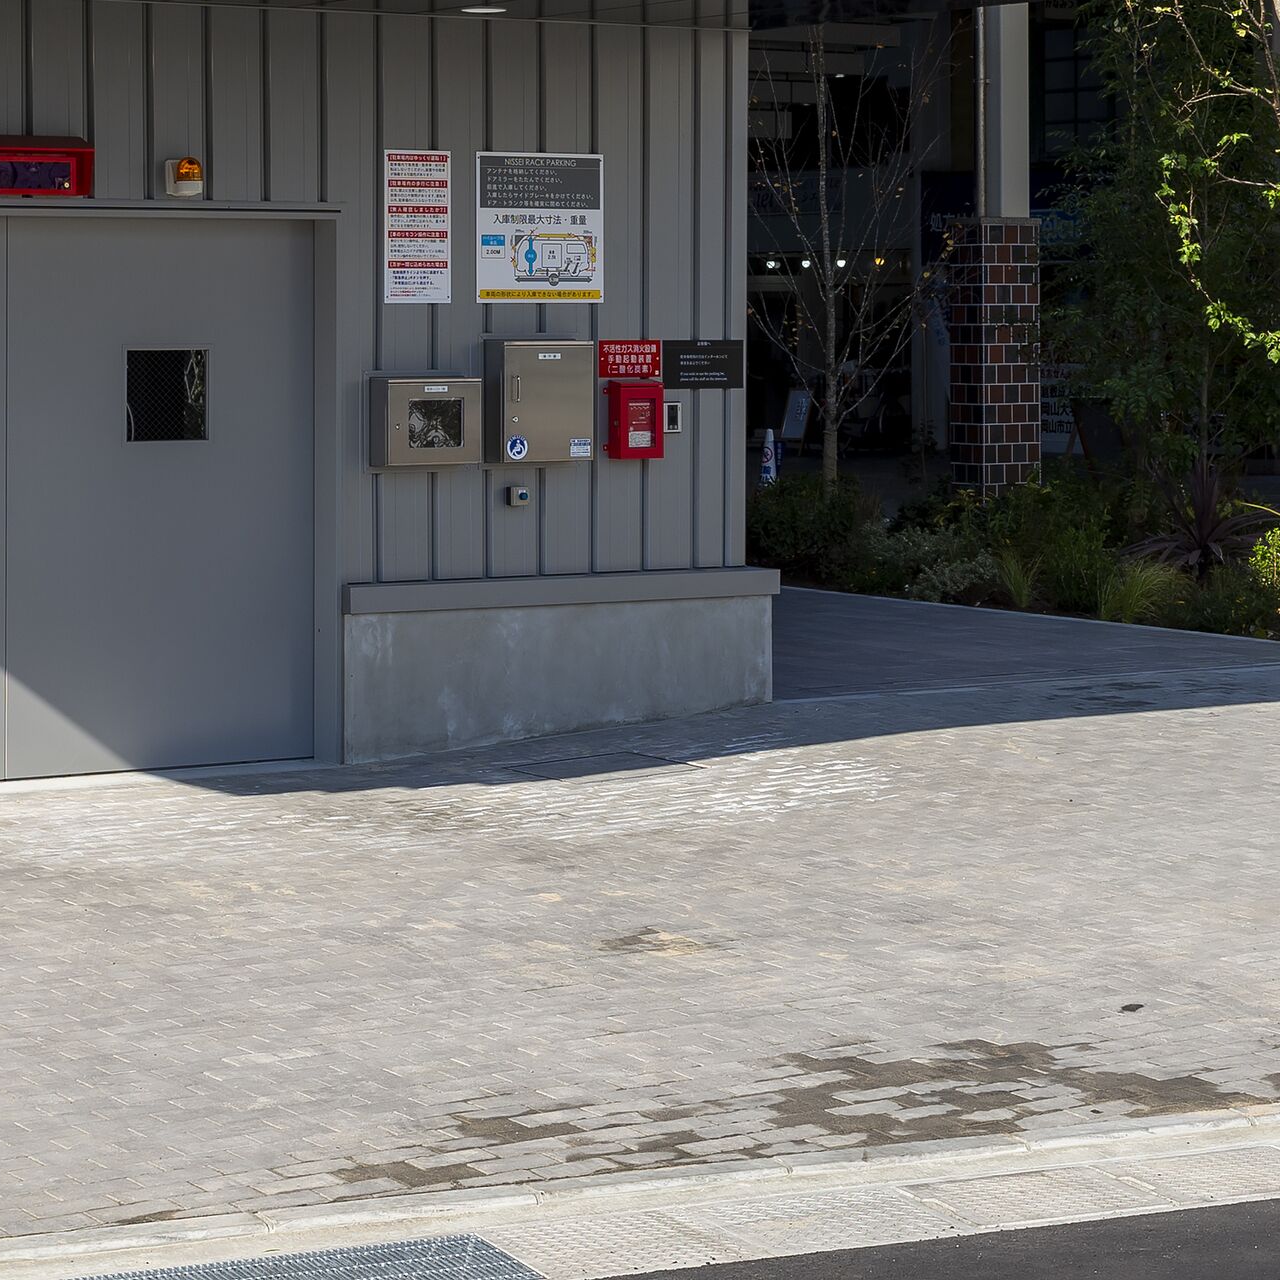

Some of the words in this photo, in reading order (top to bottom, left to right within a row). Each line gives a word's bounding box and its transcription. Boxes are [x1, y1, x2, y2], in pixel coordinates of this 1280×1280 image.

[504, 158, 524, 166] NISSEI
[525, 159, 545, 167] RACK
[546, 159, 577, 167] PARKING
[608, 354, 652, 364] 手動起動装置
